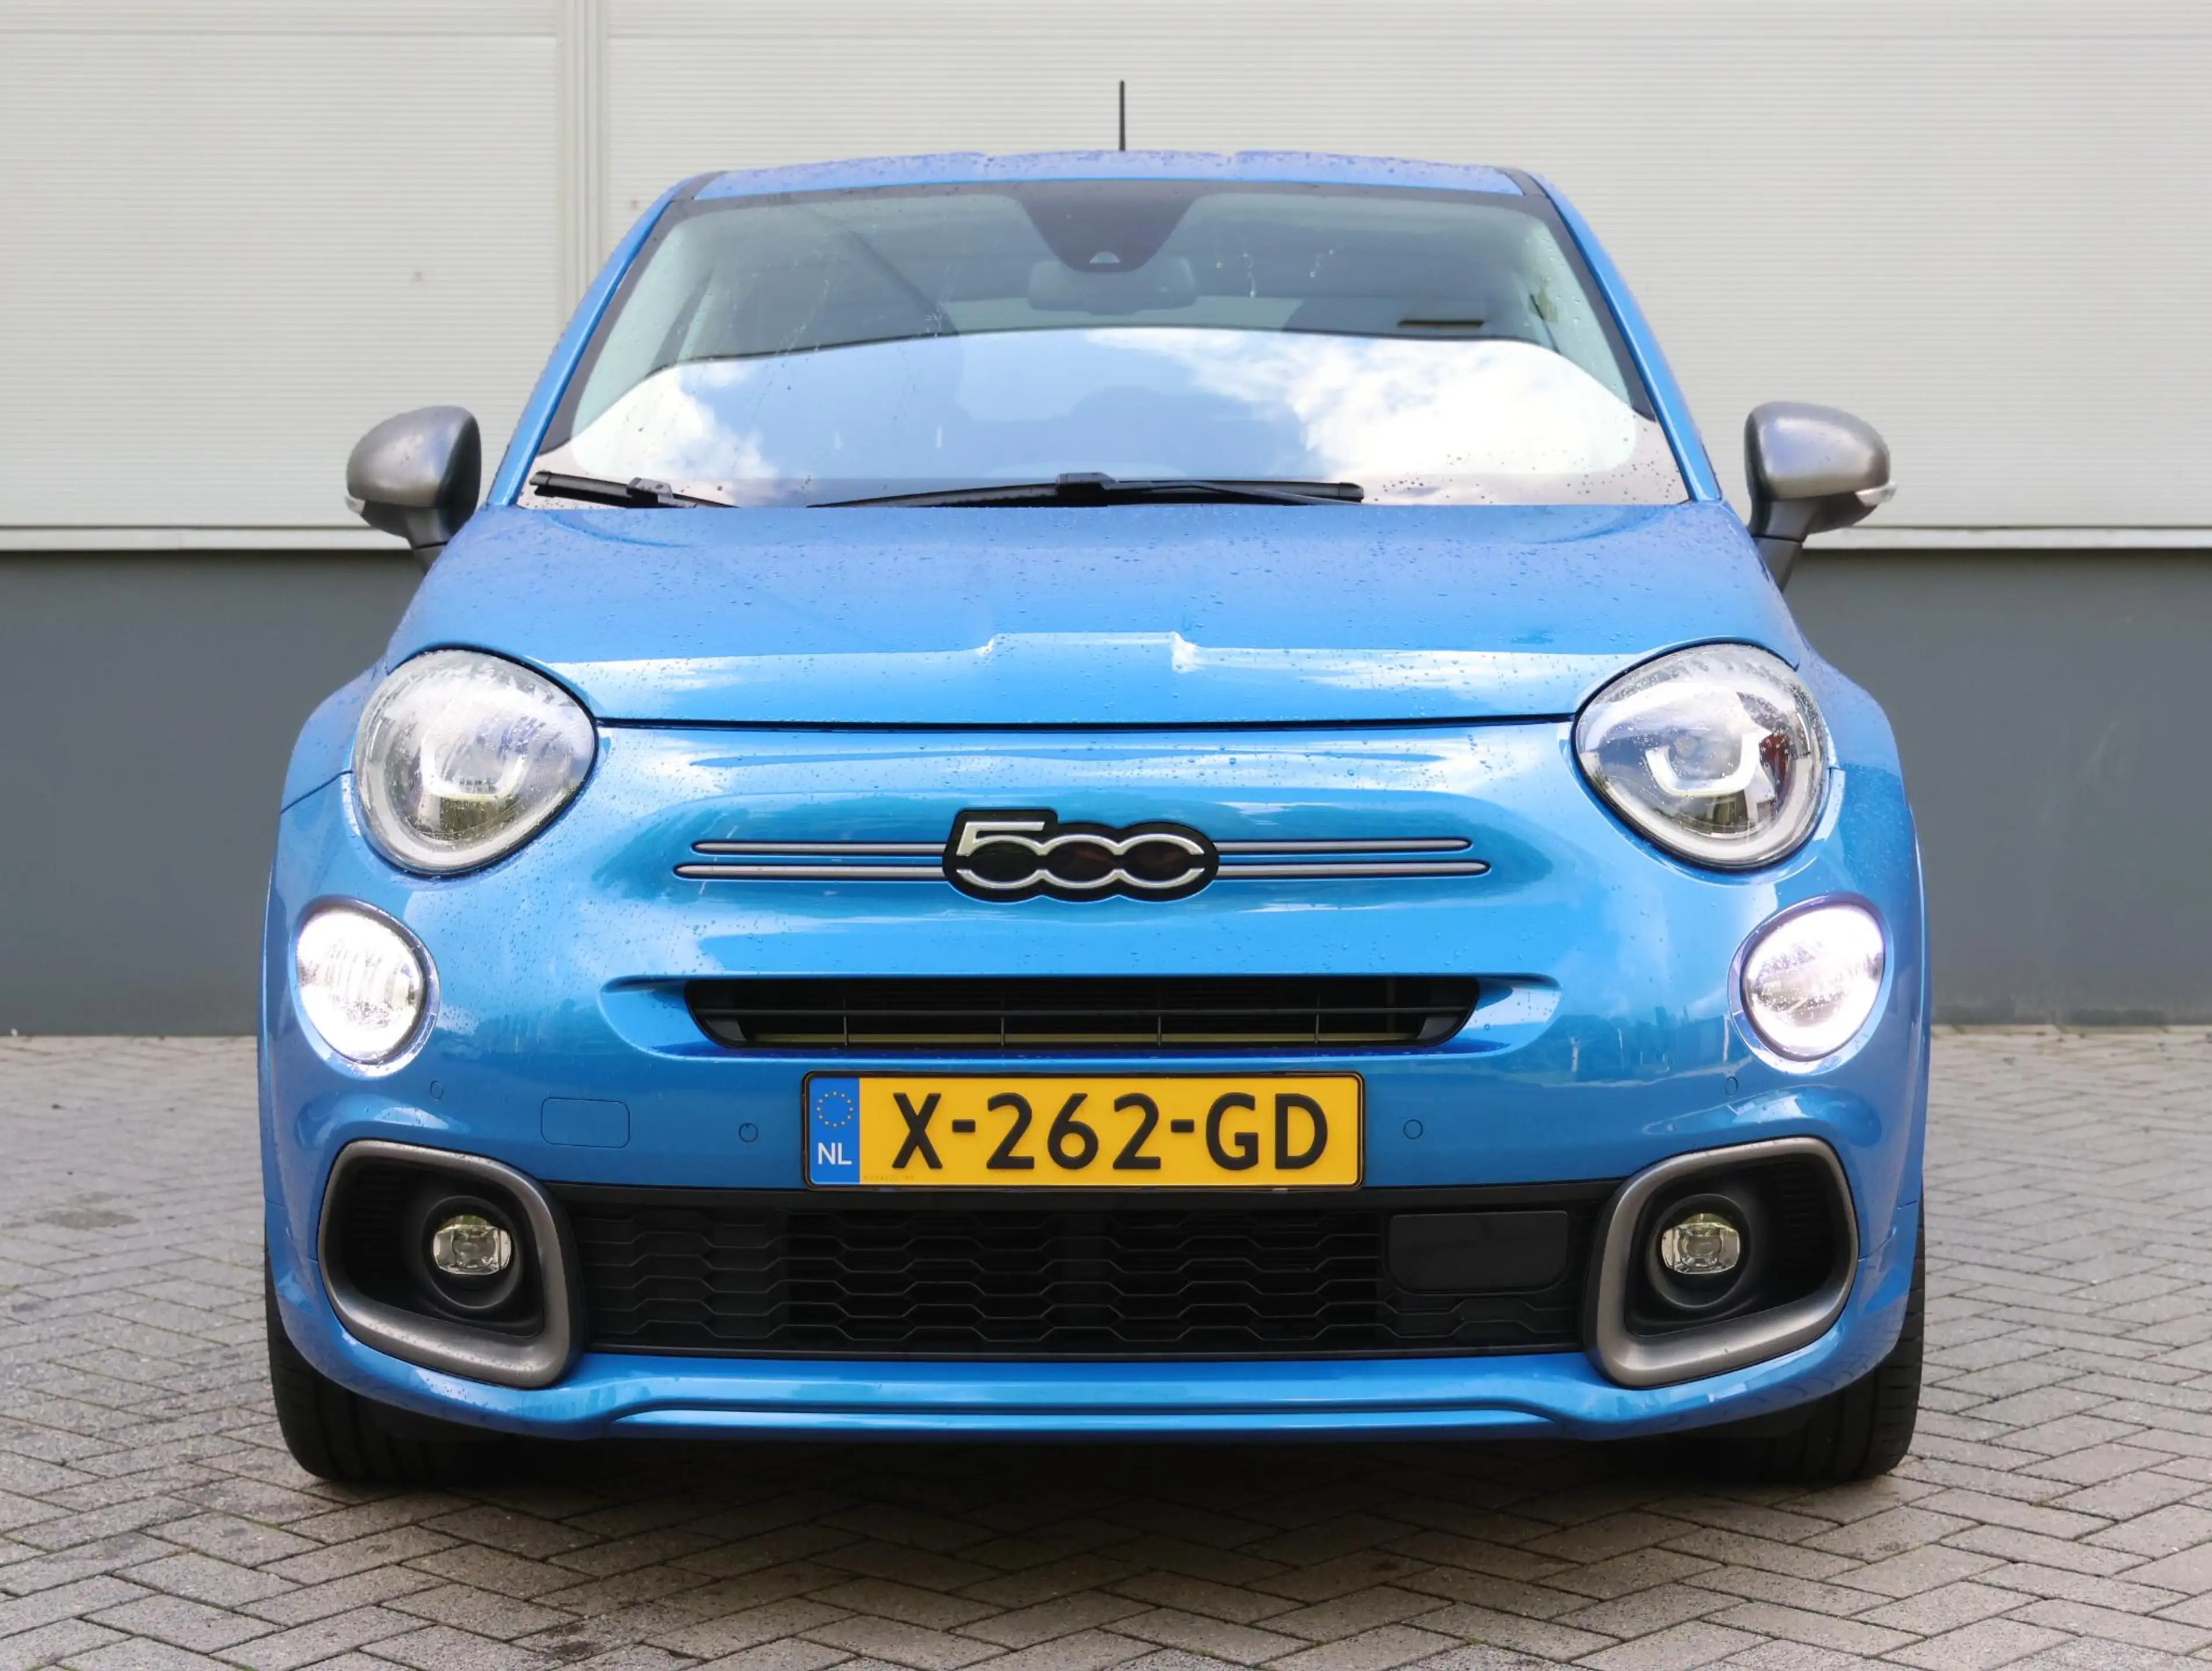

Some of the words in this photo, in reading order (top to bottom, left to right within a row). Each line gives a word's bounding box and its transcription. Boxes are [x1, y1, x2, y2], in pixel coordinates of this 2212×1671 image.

[956, 821, 1205, 889] 500
[818, 1142, 852, 1166] NL
[891, 1092, 1328, 1171] X-262-GD
